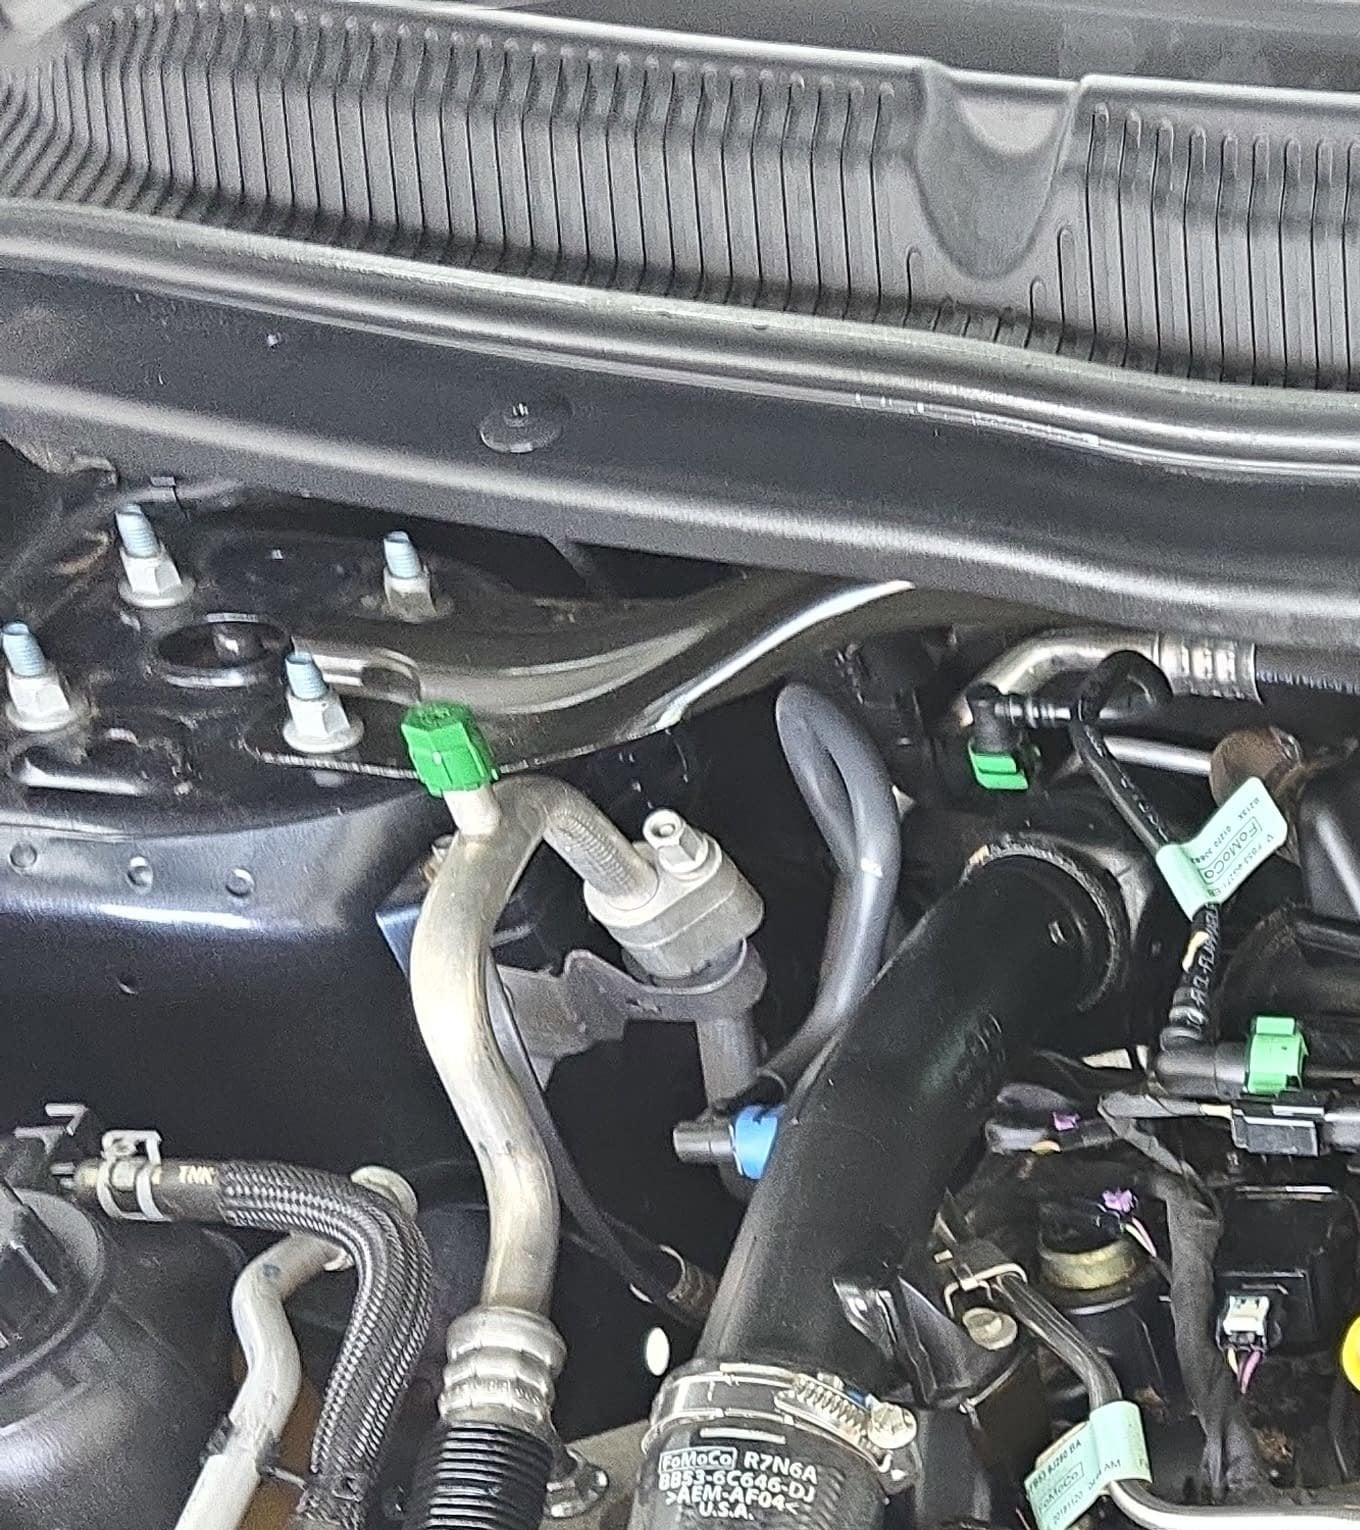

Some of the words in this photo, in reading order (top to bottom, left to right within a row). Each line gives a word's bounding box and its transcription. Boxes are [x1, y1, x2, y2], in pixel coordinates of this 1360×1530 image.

[1202, 821, 1259, 881] FoMoCo
[662, 1450, 733, 1471] FoMoCo
[744, 1451, 818, 1485] R7N6A
[699, 1501, 755, 1520] U.S.A.
